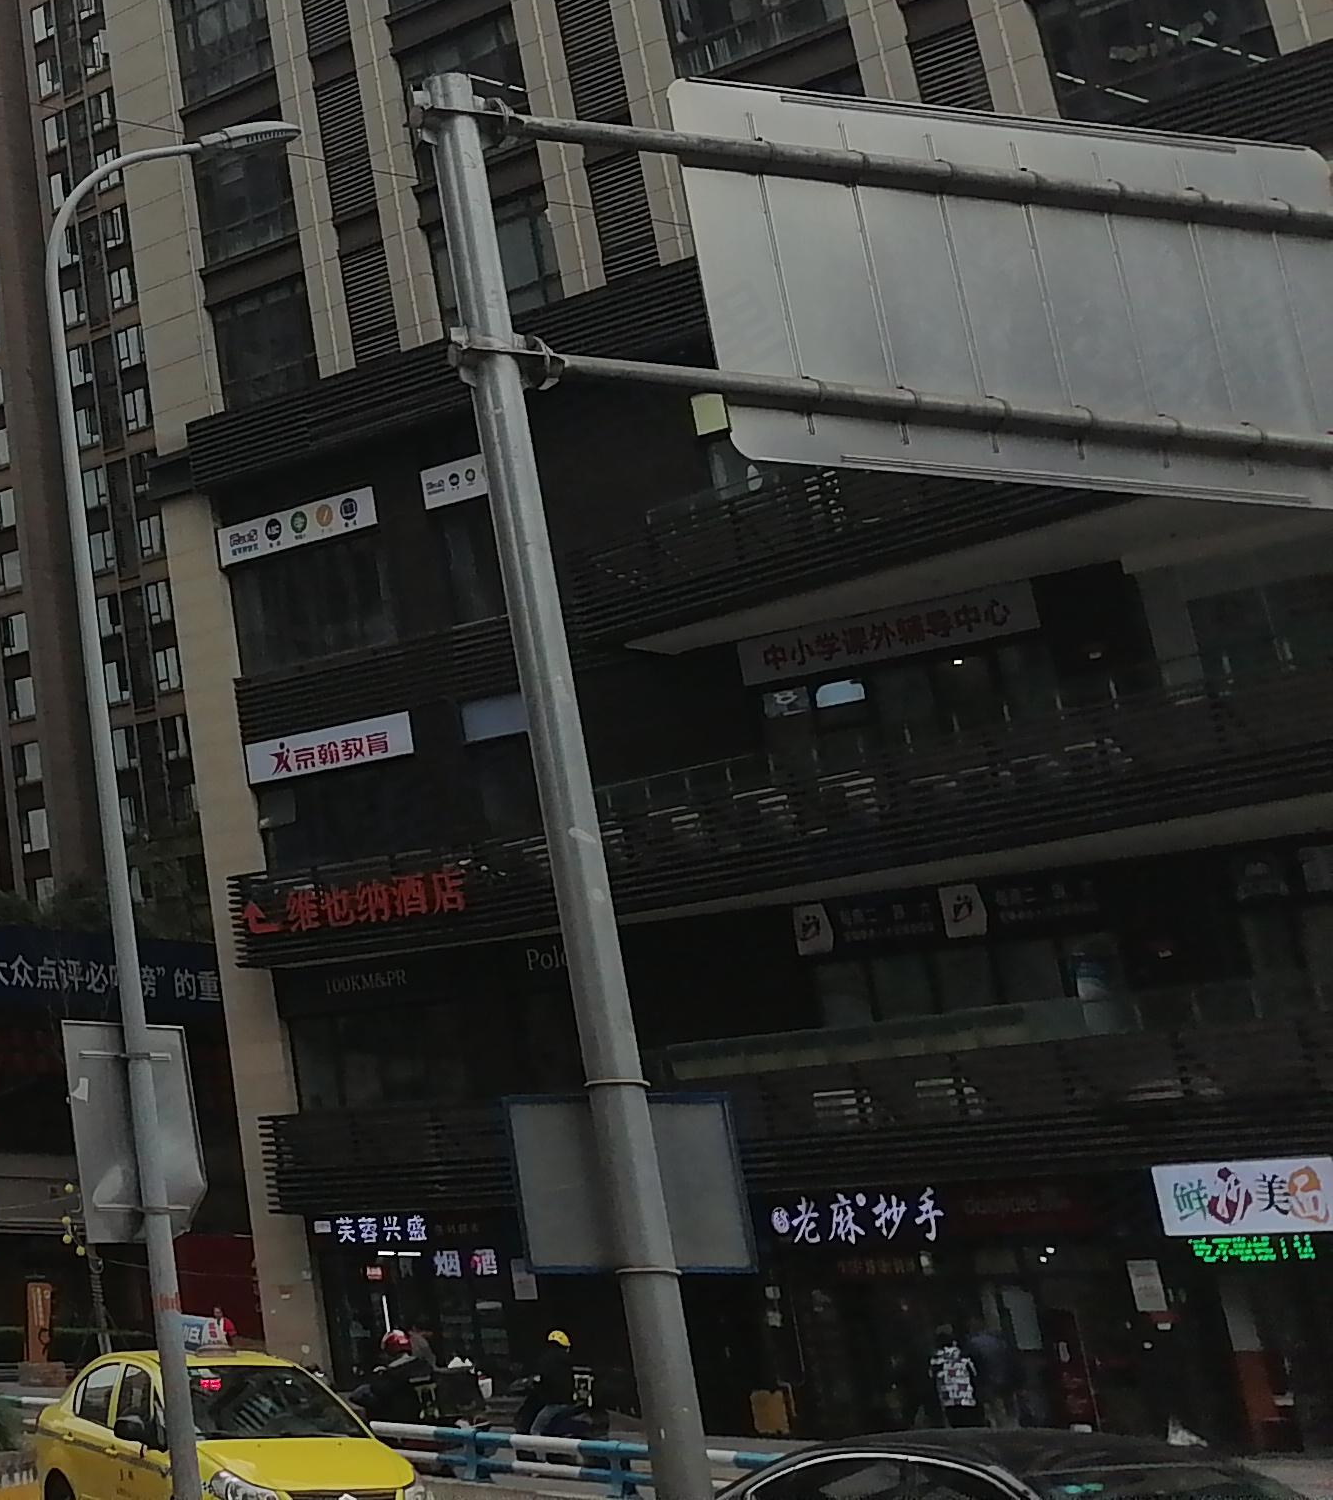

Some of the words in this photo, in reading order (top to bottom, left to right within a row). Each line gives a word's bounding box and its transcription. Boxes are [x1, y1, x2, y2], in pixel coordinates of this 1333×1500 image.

[763, 599, 1011, 670] 中小学课外辅导中心
[293, 731, 389, 770] 京翰教育
[285, 864, 468, 933] 维也纳酒店
[335, 1214, 428, 1244] 芙蓉兴盛
[791, 1186, 945, 1245] 老麻抄手
[433, 1248, 499, 1279] 烟酒
